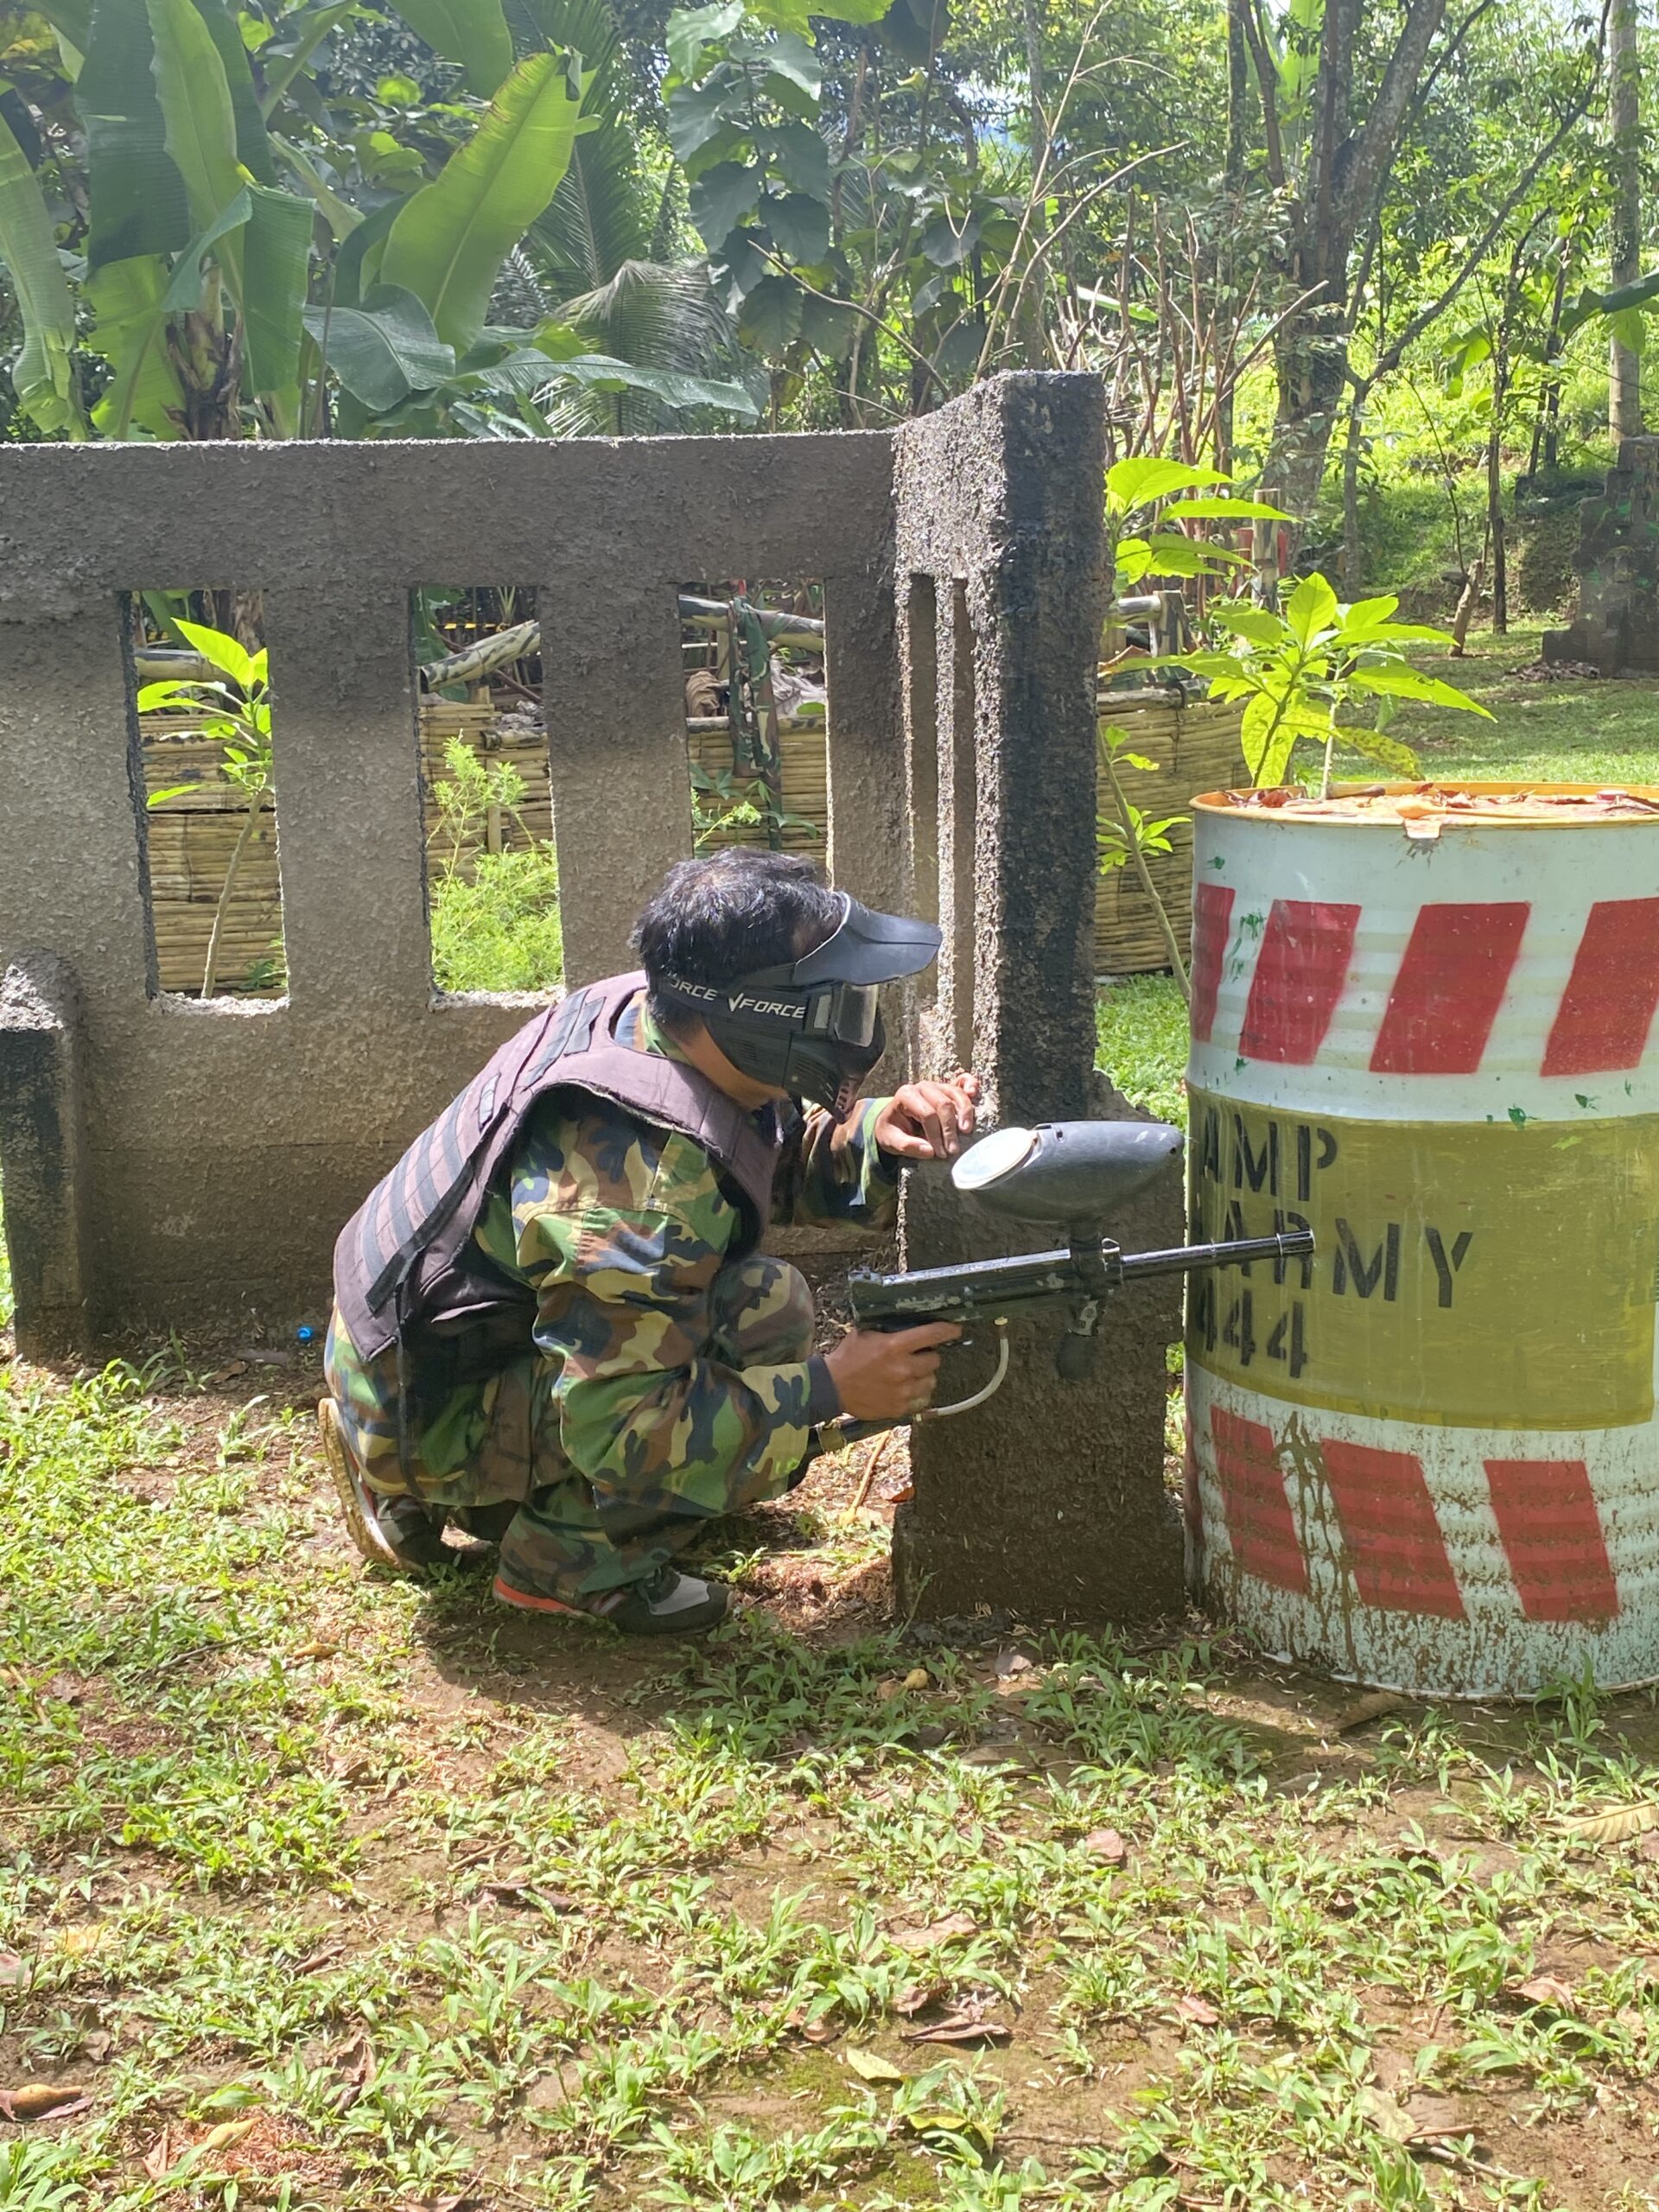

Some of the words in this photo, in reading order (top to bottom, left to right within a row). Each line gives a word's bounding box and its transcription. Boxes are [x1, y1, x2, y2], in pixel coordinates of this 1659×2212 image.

[668, 976, 719, 1001] ORCE
[728, 992, 807, 1019] VFORCE
[1218, 1199, 1473, 1307] ARMY
